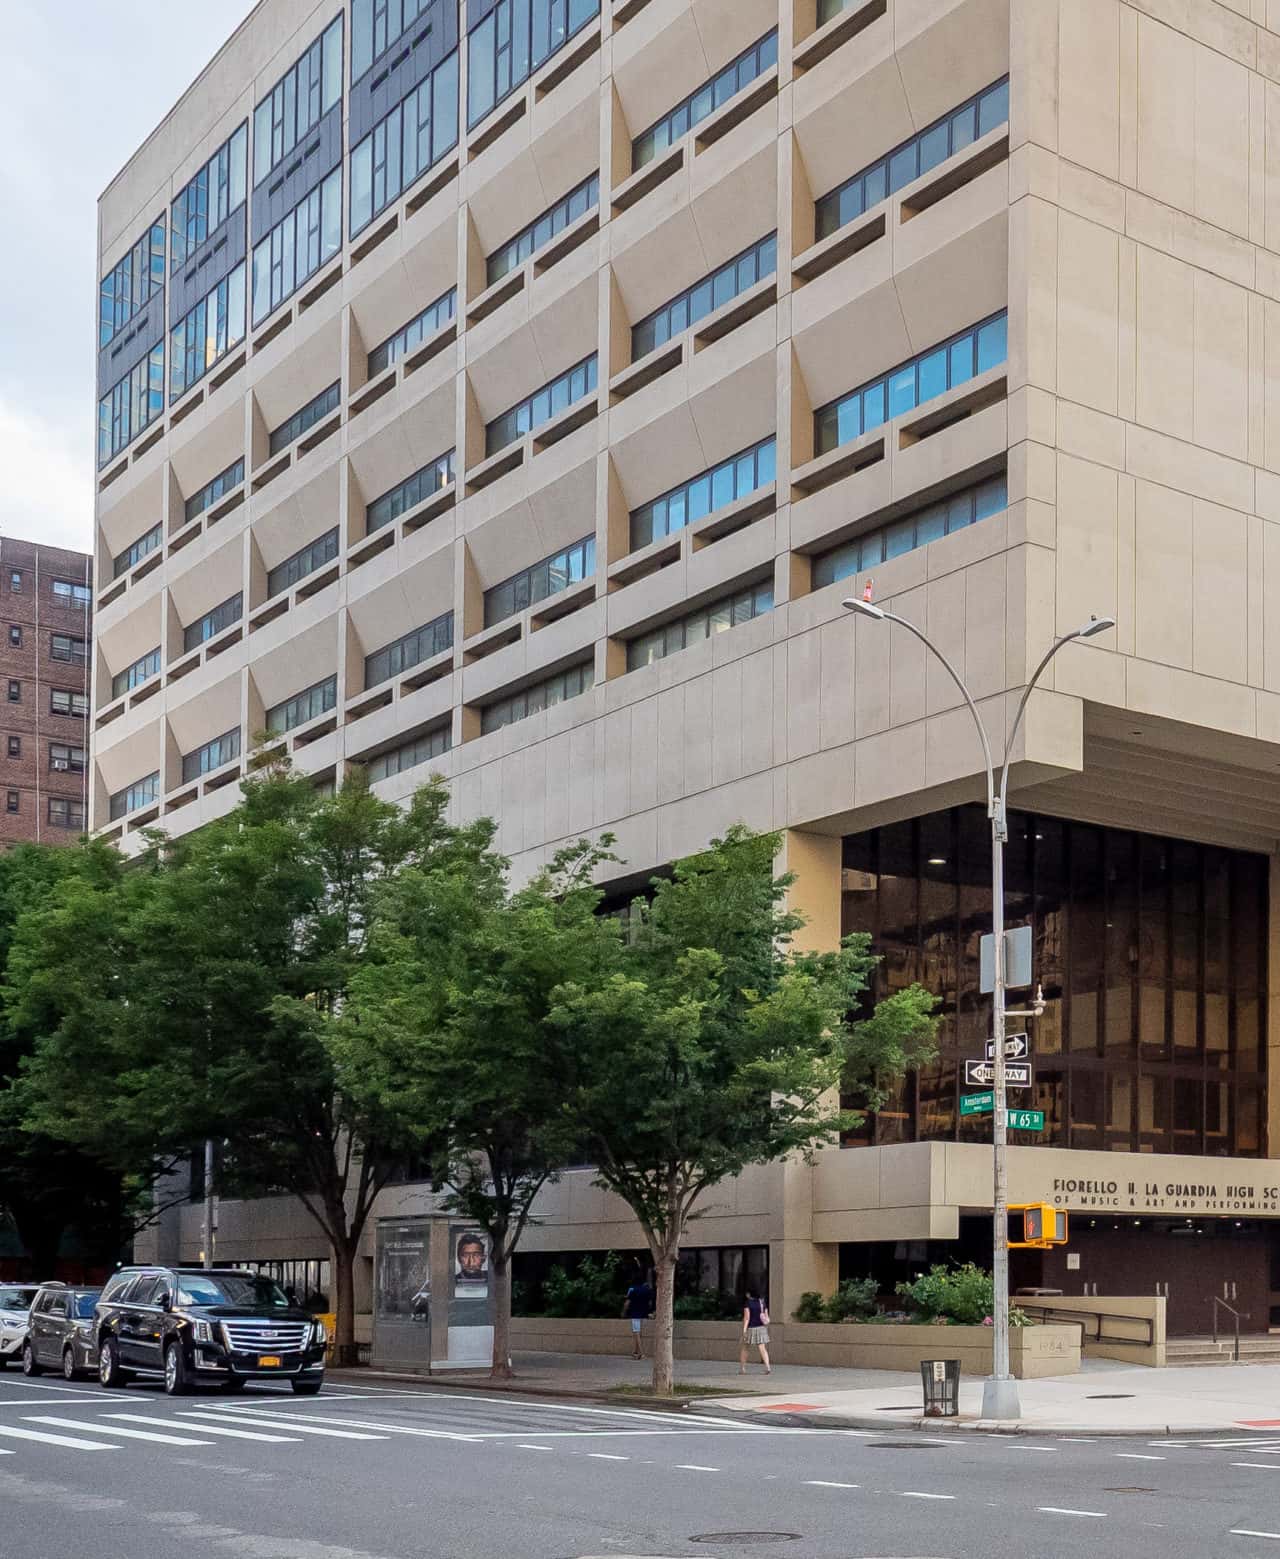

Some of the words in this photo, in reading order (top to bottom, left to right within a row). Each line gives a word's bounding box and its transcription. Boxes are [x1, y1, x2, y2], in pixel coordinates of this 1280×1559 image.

[976, 1068, 995, 1078] ONE
[1010, 1112, 1016, 1125] W
[1020, 1114, 1030, 1127] 65
[1054, 1179, 1117, 1194] FIORELLO
[1145, 1183, 1158, 1196] LA
[1165, 1184, 1217, 1197] GUARDIA
[1226, 1186, 1254, 1198] HIGH
[1054, 1195, 1069, 1204] OF
[1080, 1196, 1119, 1206] MUSIC
[1145, 1198, 1164, 1206] ART
[1175, 1200, 1195, 1208] AND
[1206, 1201, 1276, 1209] PERFORMING
